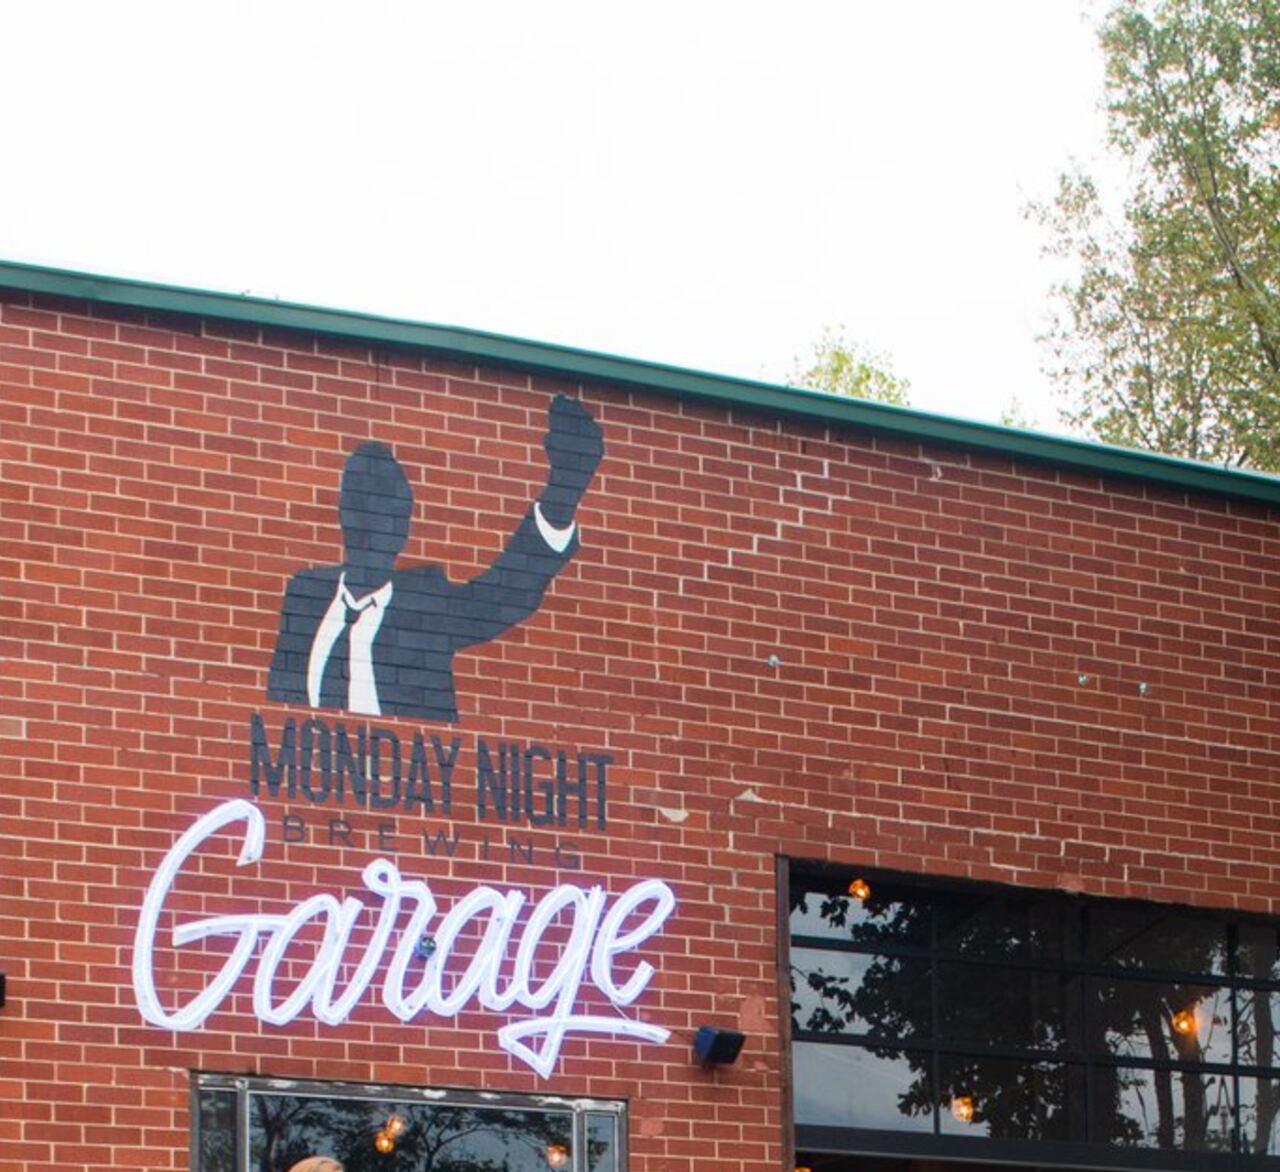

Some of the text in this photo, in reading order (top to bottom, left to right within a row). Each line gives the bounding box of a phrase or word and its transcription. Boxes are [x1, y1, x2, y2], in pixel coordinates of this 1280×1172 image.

[250, 714, 614, 831] MONDAY NIGHT
[284, 817, 582, 870] BREWING
[133, 798, 675, 1079] Garage
